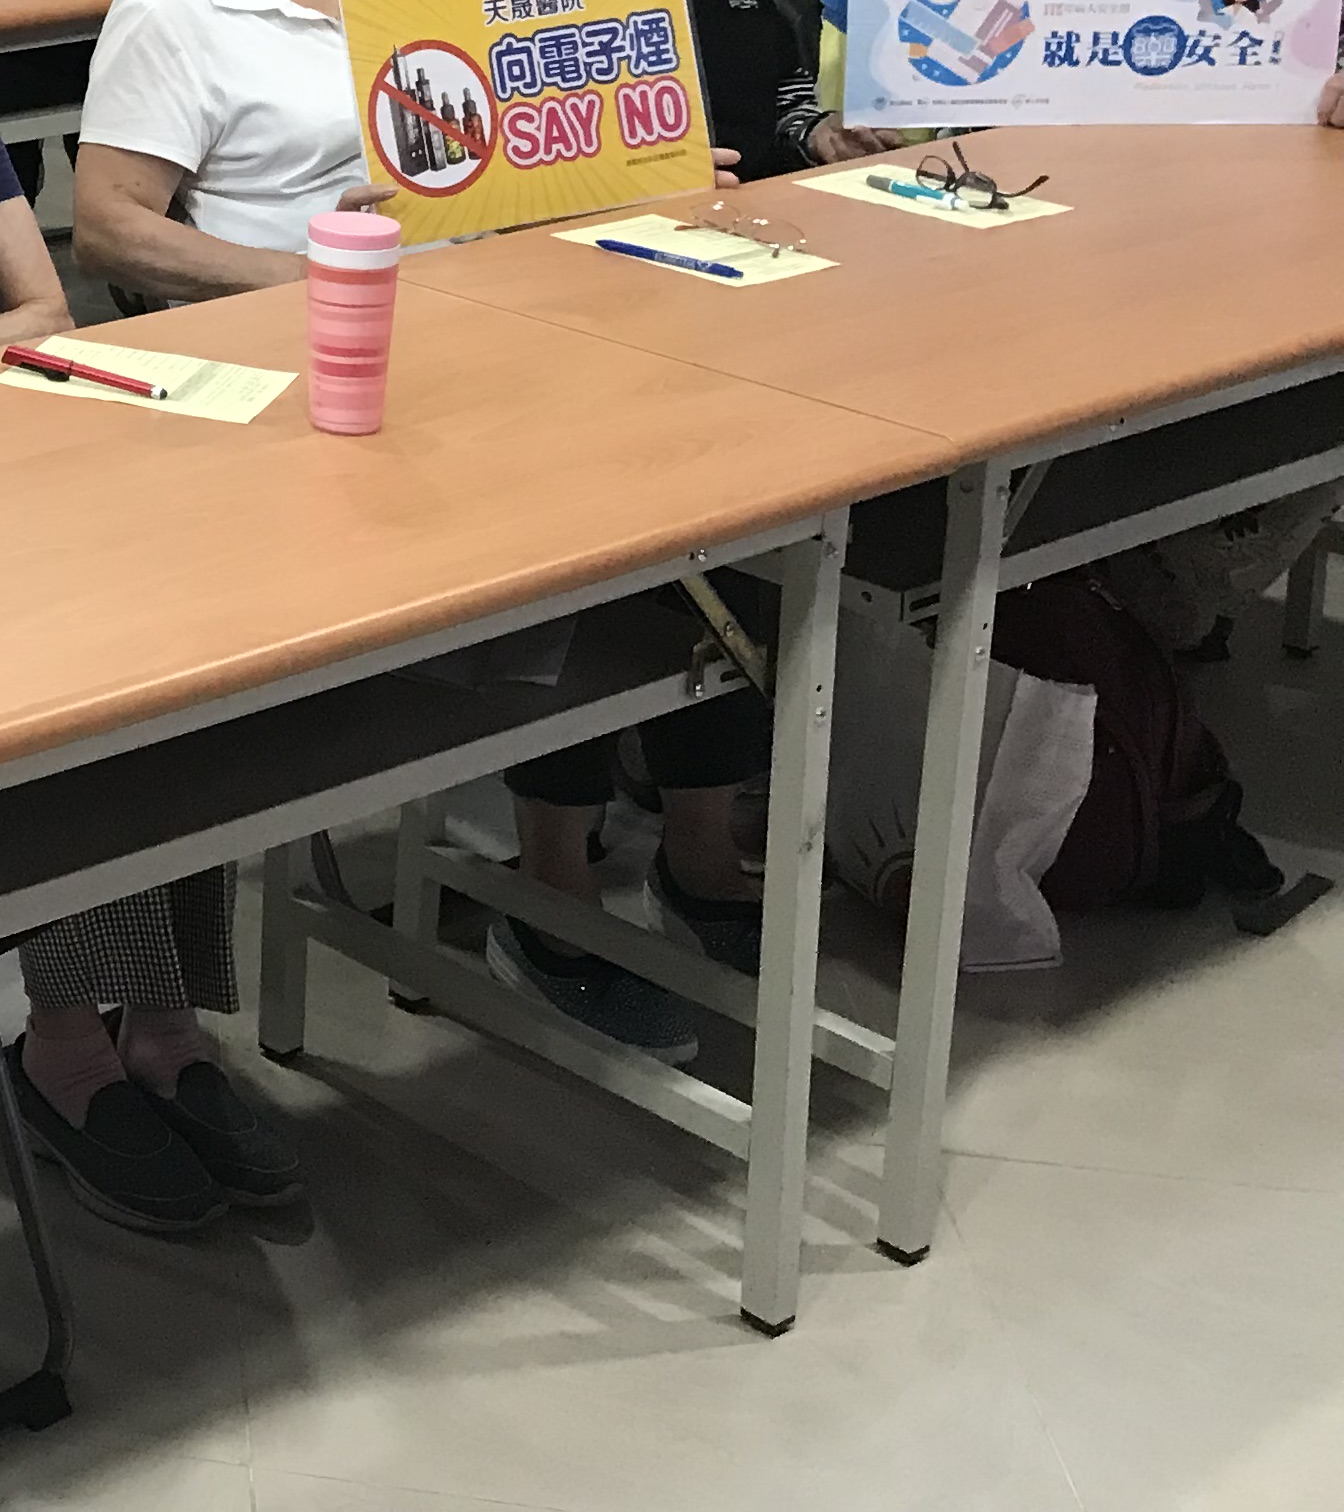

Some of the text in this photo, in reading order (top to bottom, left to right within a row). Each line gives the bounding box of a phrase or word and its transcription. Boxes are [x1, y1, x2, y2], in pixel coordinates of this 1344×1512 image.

[491, 11, 677, 99] 向電子煙
[504, 78, 689, 168] SAY NO
